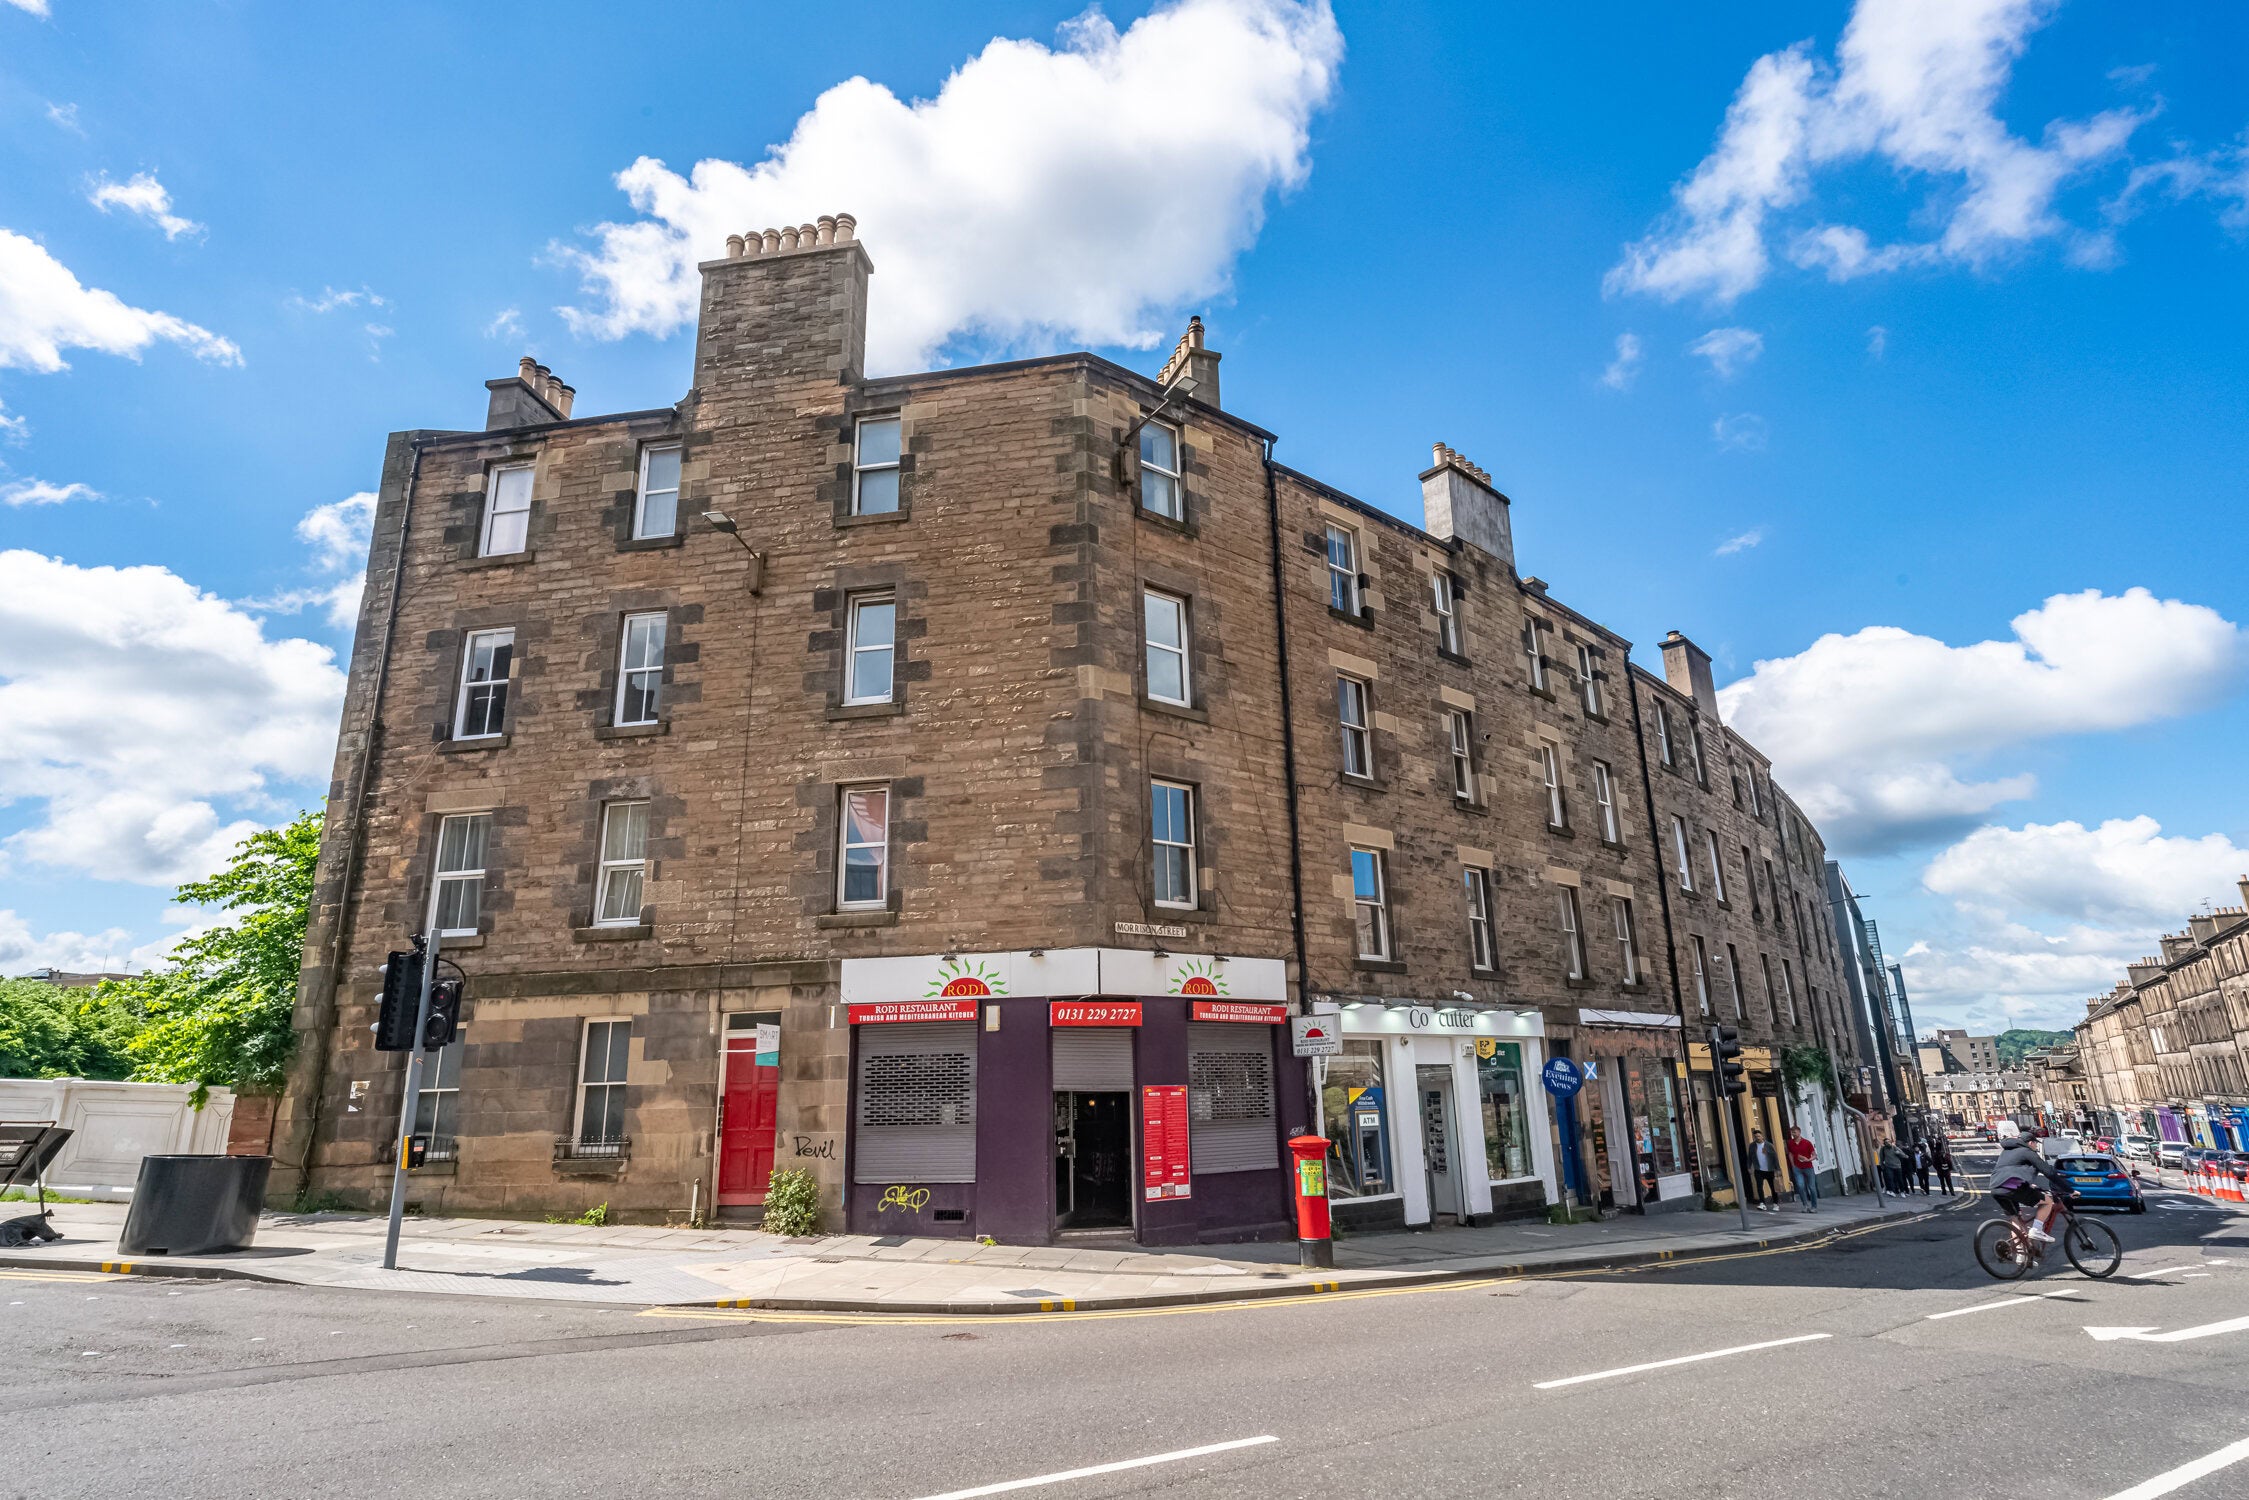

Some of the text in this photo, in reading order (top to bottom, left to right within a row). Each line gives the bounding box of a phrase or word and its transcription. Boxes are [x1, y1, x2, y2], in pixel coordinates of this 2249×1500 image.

[1117, 923, 1184, 936] MORRISON STREET
[947, 984, 984, 996] RODI
[1185, 983, 1213, 994] RODI
[875, 1003, 958, 1014] RODI RESTAURANT
[1057, 1008, 1137, 1020] 0131 229 2727
[1212, 1004, 1272, 1015] RODI RESTAURANT
[859, 1014, 885, 1022] TURKISH
[899, 1012, 947, 1020] MEDITERRANEAN
[949, 1011, 974, 1019] KITCHEN
[1409, 1009, 1475, 1029] Co cutter
[1545, 1069, 1578, 1085] Evening
[1550, 1078, 1572, 1090] News
[793, 1136, 836, 1160] Devil
